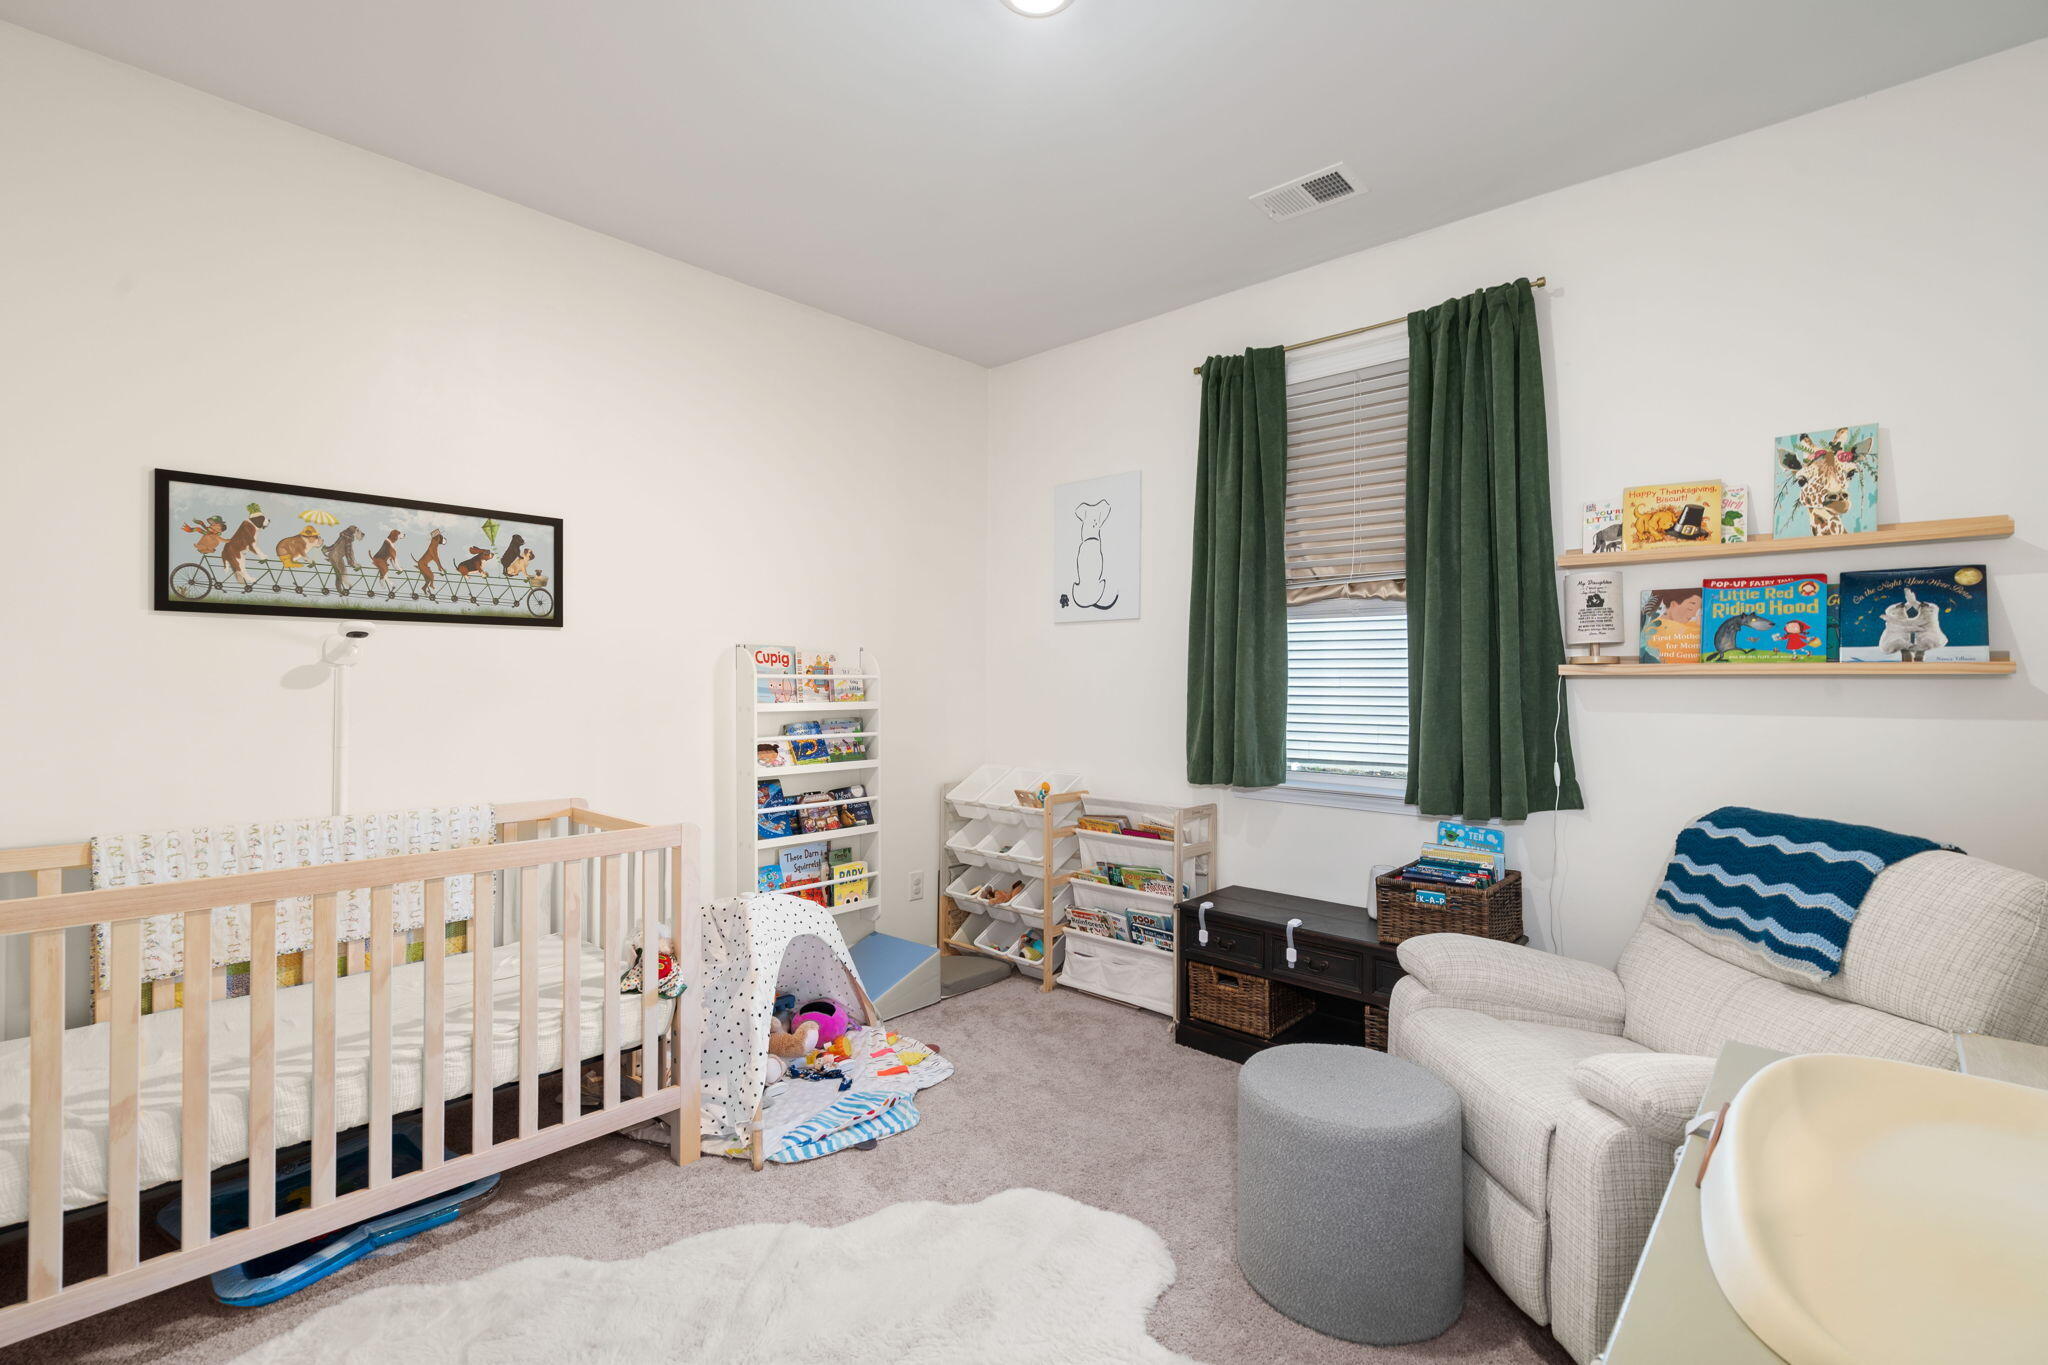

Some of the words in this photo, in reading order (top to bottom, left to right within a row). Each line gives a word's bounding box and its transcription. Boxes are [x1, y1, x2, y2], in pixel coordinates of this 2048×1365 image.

[1628, 490, 1657, 499] Happy
[1659, 485, 1718, 496] Thanksgiving,
[1655, 494, 1688, 503] Biscuit!
[1586, 515, 1619, 524] LITTLE
[1710, 580, 1747, 588] POP-UP
[1749, 578, 1775, 587] FAIRY
[1877, 580, 1902, 592] Night
[1904, 577, 1924, 587] You
[1719, 588, 1760, 602] Little
[1765, 586, 1794, 600] Red
[1712, 601, 1766, 619] Riding
[1769, 598, 1819, 615] Hood
[755, 650, 790, 668] Cupig
[1468, 831, 1485, 841] TEN
[804, 848, 820, 859] Darn
[793, 858, 821, 873] Squirrels!
